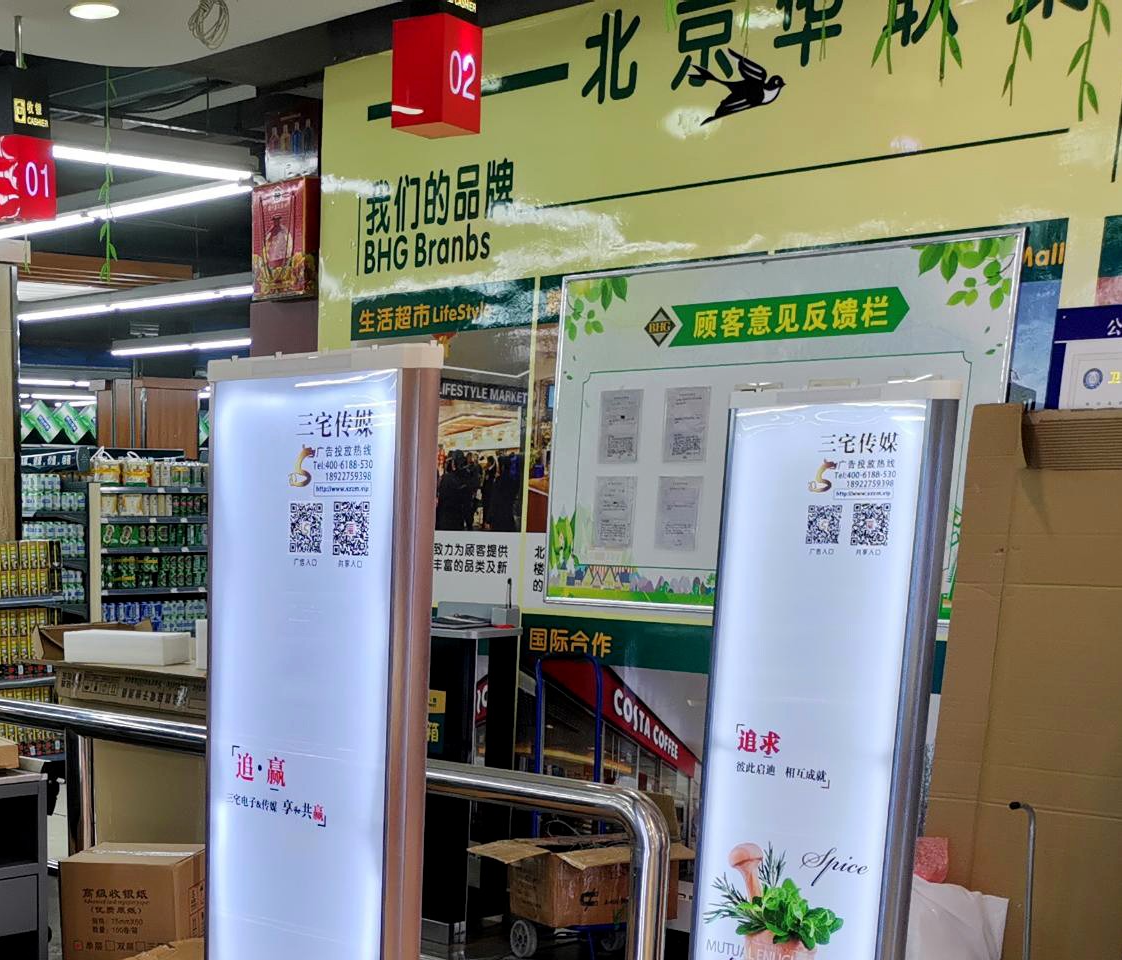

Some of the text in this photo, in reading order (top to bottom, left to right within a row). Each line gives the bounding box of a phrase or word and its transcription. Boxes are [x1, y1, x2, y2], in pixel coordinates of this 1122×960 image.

[449, 50, 476, 100] 02
[27, 116, 49, 128] CASHIER
[25, 161, 49, 198] 01
[365, 158, 514, 236] 我们的品牌
[364, 223, 491, 274] BHG Branbs
[358, 304, 430, 334] 生活超市
[692, 294, 890, 340] 顾客意见反馈栏
[440, 382, 528, 404] IFESTYLE MARKET
[315, 444, 372, 457] 广告投放热线
[818, 432, 899, 454] 三宅传媒
[325, 472, 372, 481] 18922759398
[434, 543, 509, 558] 致力为顾客提供
[534, 546, 546, 560] 北
[433, 558, 508, 575] 丰富的品类及新
[532, 577, 544, 593] 的
[529, 627, 613, 658] 国际合作
[613, 688, 679, 760] COSTA COFFEE
[737, 728, 781, 755] 追求
[736, 760, 827, 782] 彼此启迪 相互成就
[800, 847, 870, 887] Spice
